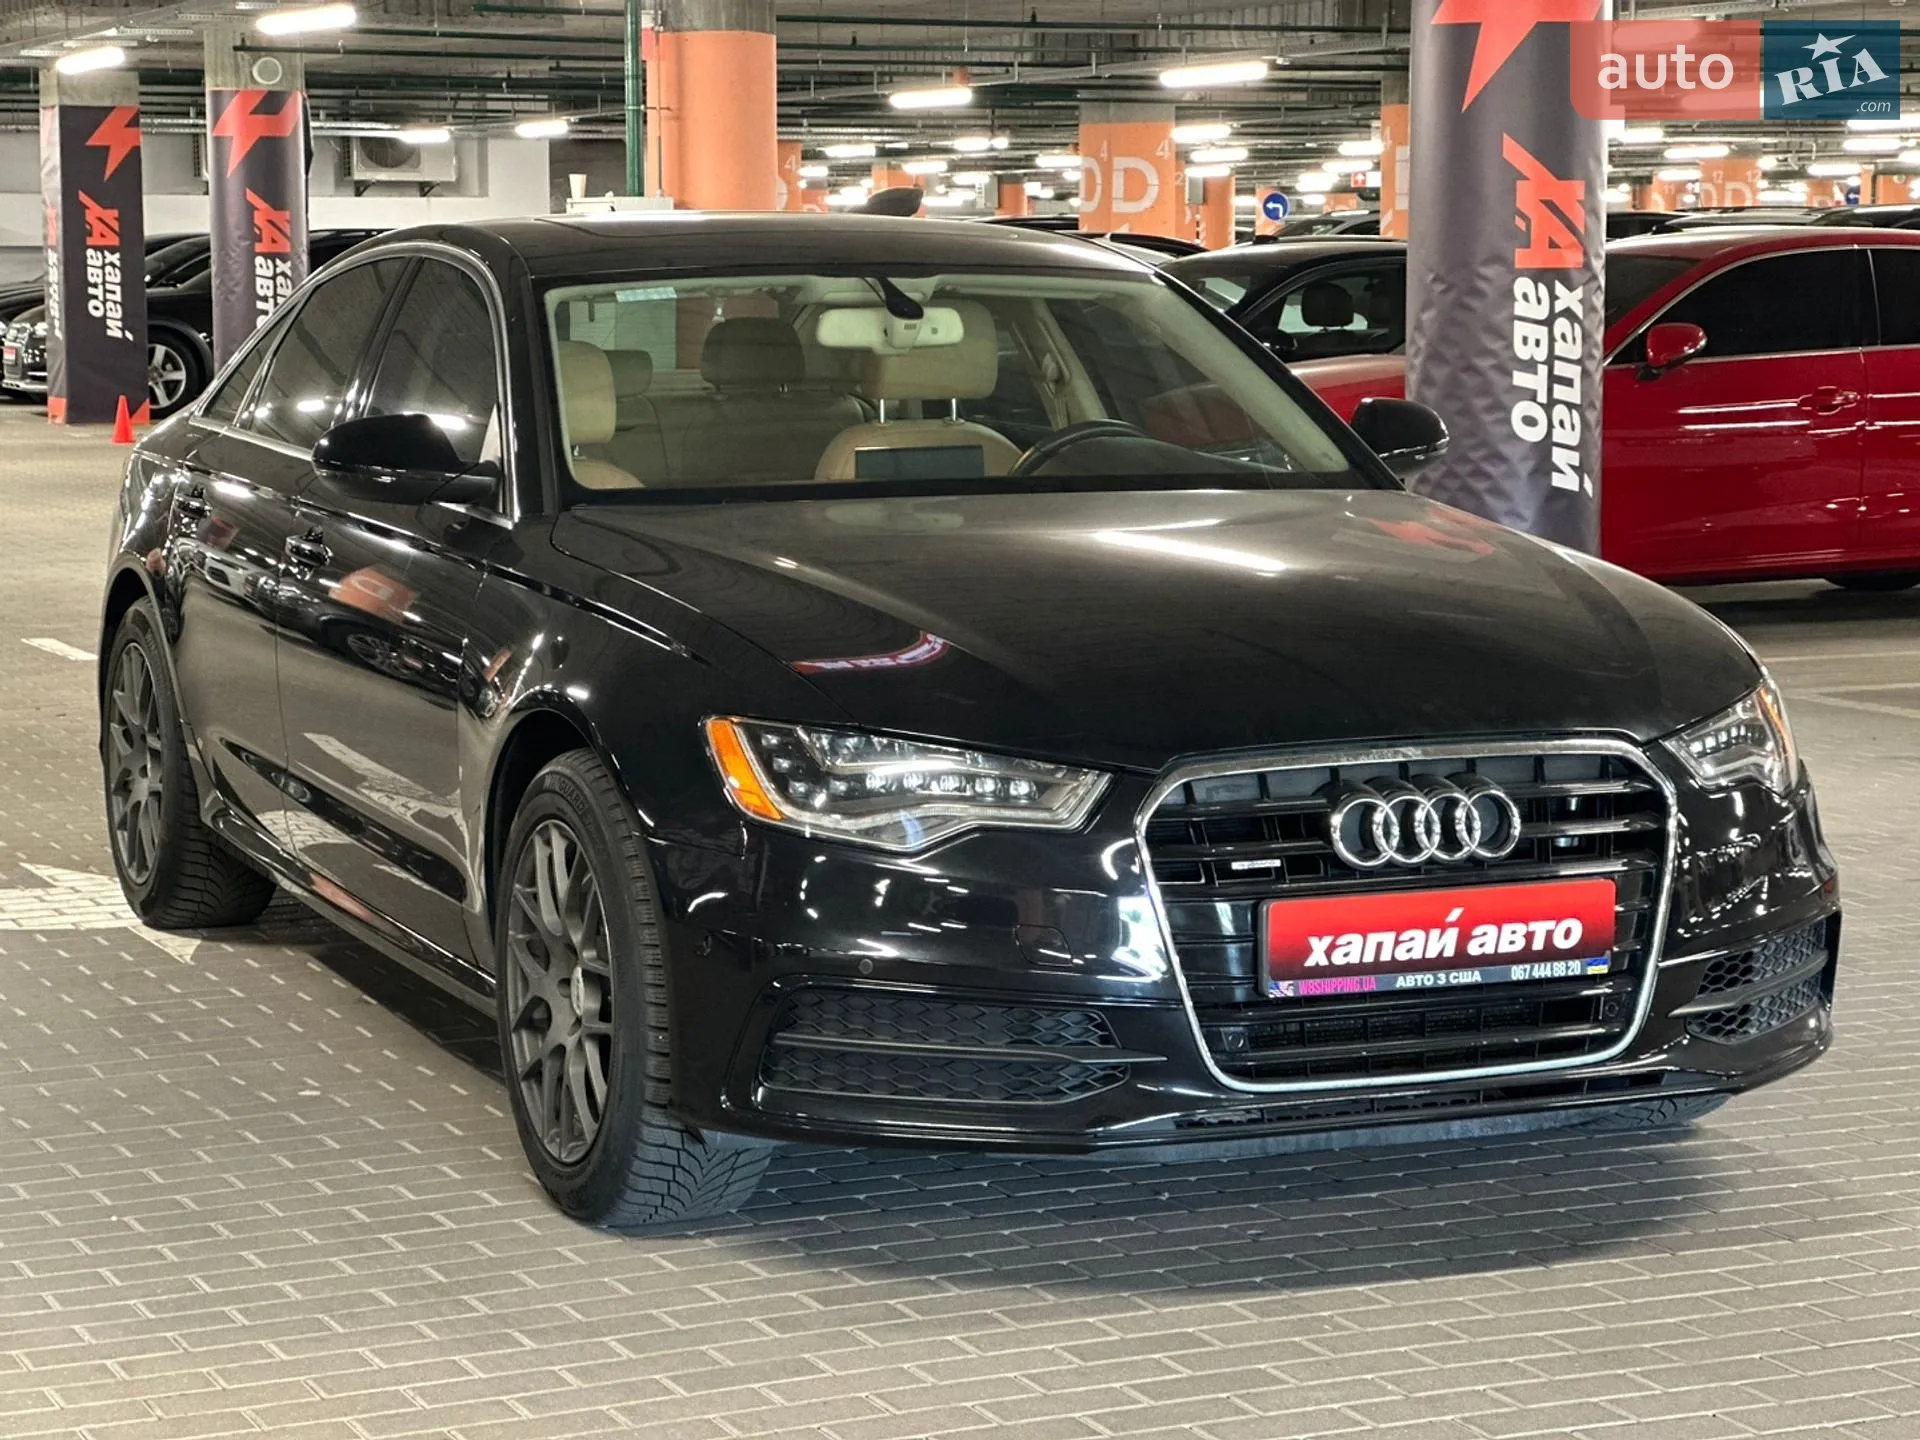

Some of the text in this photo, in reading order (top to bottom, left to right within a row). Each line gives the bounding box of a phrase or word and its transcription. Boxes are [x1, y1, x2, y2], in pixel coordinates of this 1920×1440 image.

[784, 155, 796, 171] 4
[1155, 139, 1171, 160] 4
[1112, 156, 1160, 213] D
[86, 248, 105, 318] авто
[104, 249, 134, 341] хапай
[1511, 276, 1550, 442] авто
[1552, 279, 1593, 498] хапай
[1304, 907, 1583, 966] хапай авто
[1396, 974, 1434, 988] АВТО
[1448, 970, 1482, 984] США
[1511, 965, 1530, 980] 067
[1532, 963, 1551, 978] 444
[1568, 960, 1581, 975] 20
